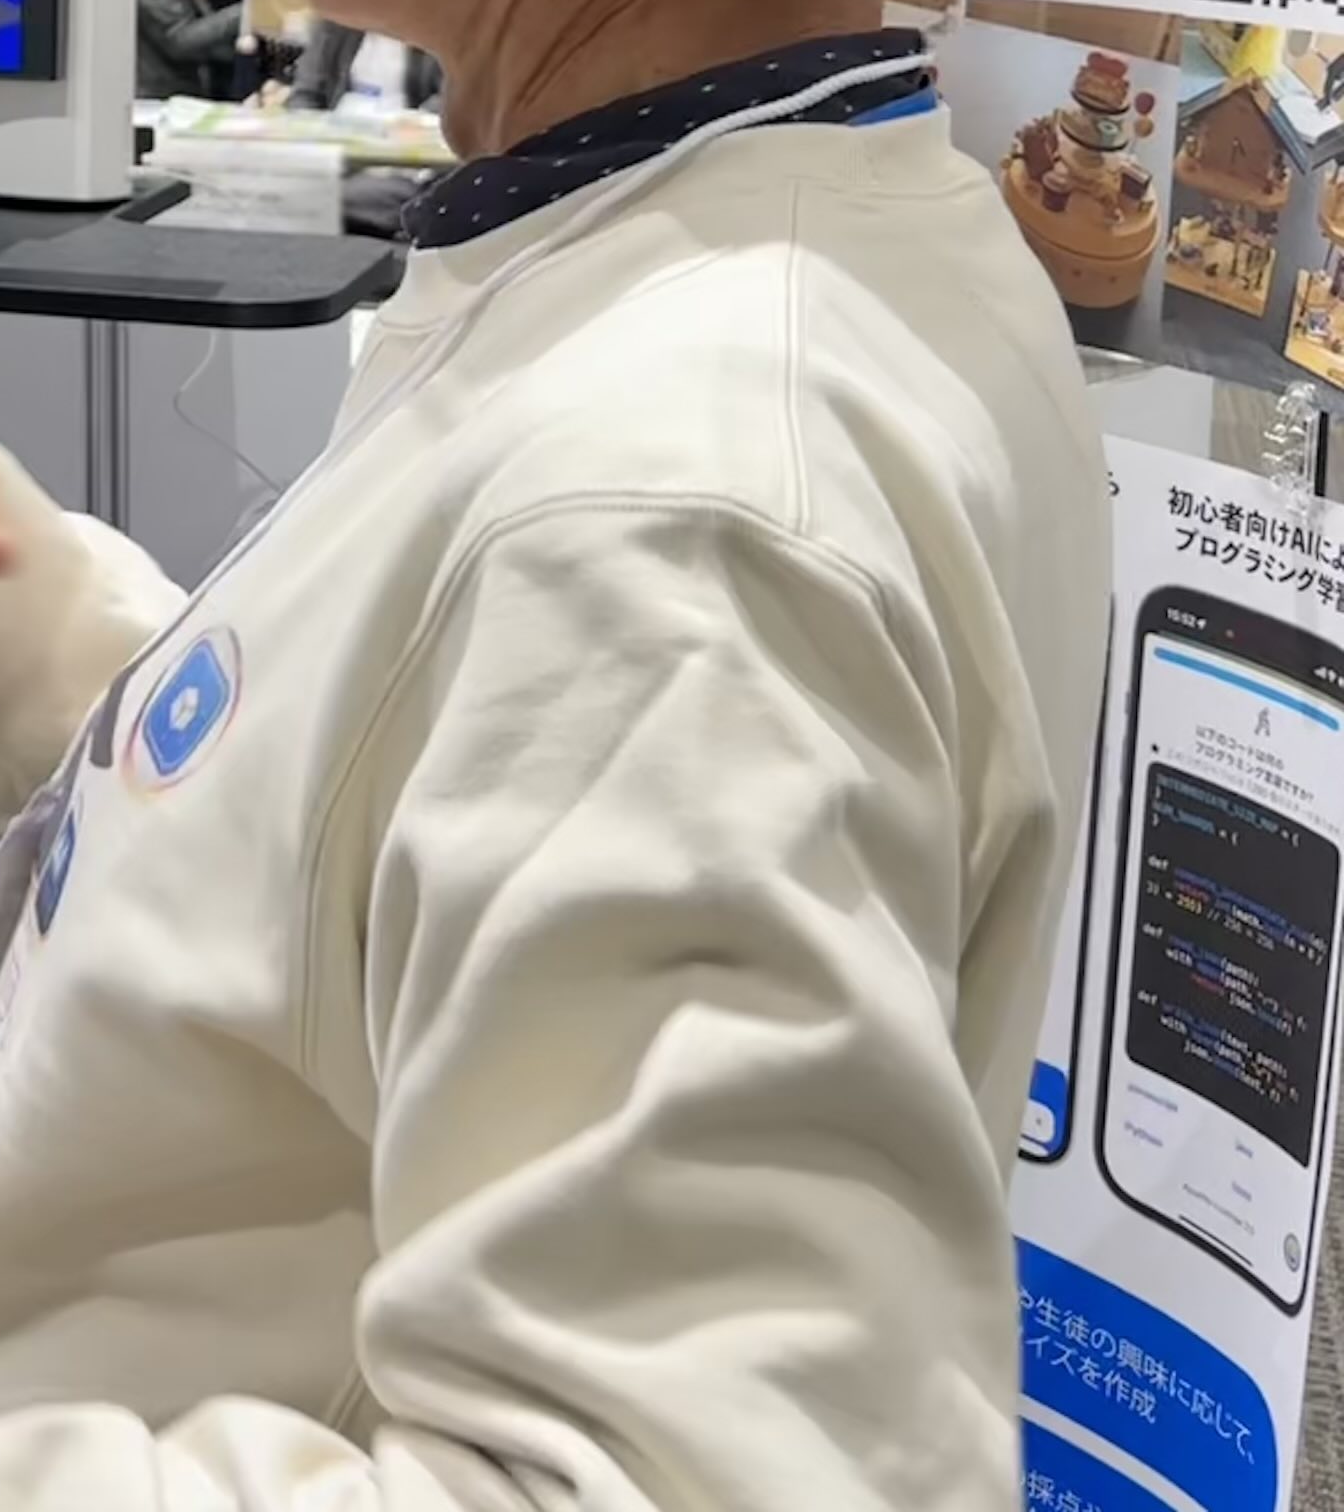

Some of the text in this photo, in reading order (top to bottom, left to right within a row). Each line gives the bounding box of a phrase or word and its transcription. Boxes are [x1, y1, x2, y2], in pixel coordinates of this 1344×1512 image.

[1020, 1335, 1157, 1425] イズを作成
